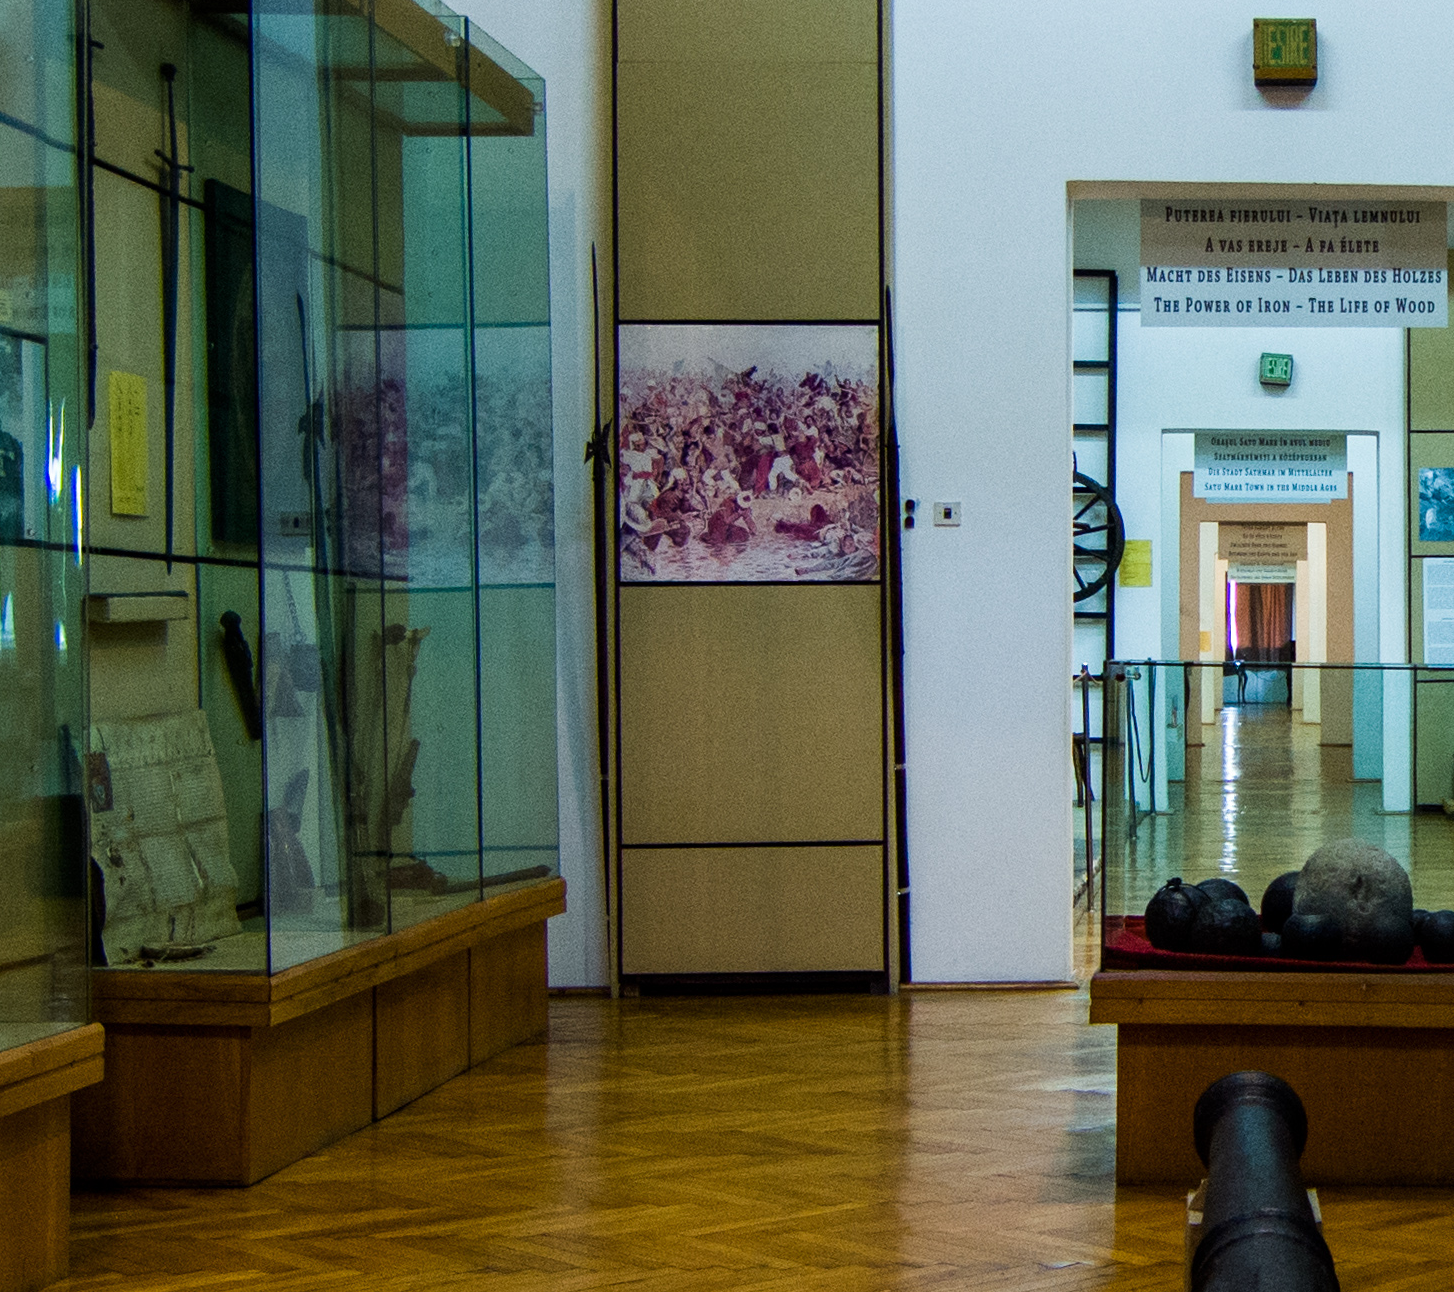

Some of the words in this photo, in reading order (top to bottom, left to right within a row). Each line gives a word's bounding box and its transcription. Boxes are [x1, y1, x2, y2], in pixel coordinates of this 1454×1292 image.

[1166, 206, 1224, 222] PUTEREA
[1230, 209, 1292, 222] FIERULUI
[1354, 209, 1421, 223] LEMNULUI
[1205, 237, 1214, 252] A
[1219, 240, 1243, 252] VAS
[1249, 240, 1288, 253] EREJE
[1305, 237, 1315, 252] A
[1320, 240, 1335, 252] FA
[1147, 266, 1192, 283] MACHT
[1198, 269, 1221, 283] DES
[1227, 267, 1271, 283] EISENS
[1289, 267, 1313, 283] DAS
[1319, 268, 1359, 283] LEBEN
[1364, 269, 1387, 283] DES
[1393, 267, 1442, 283] HOLZES
[1154, 297, 1180, 312] THE
[1186, 297, 1231, 312] POWER
[1237, 300, 1252, 312] OF
[1258, 297, 1291, 312] IRON
[1309, 298, 1334, 313] THE
[1341, 298, 1369, 313] LIFE
[1375, 301, 1390, 313] OF
[1396, 298, 1436, 313] WOOD
